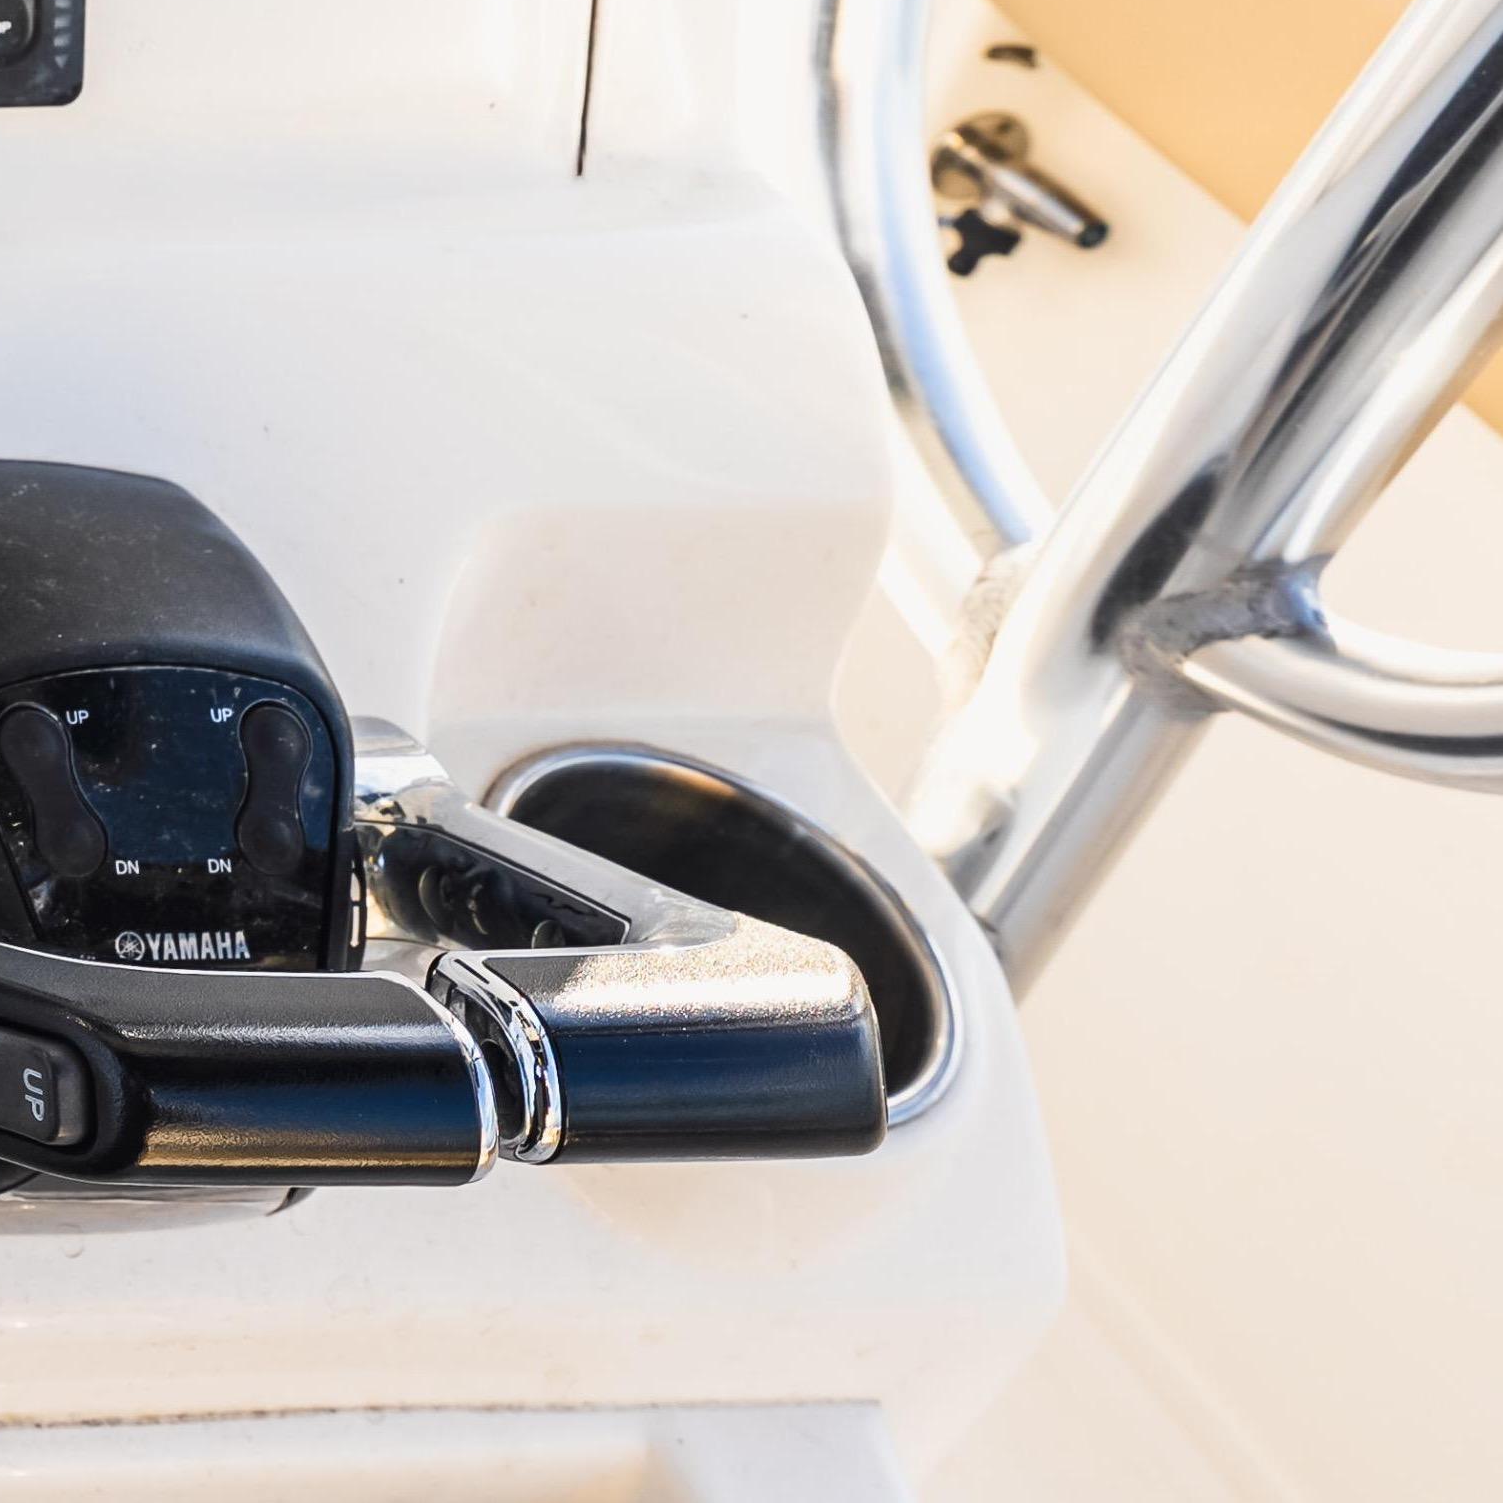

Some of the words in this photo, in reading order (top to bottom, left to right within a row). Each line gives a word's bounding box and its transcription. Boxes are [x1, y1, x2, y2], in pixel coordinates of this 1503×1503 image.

[65, 709, 89, 727] UP
[210, 707, 234, 724] UP
[115, 859, 140, 876] DN
[207, 857, 232, 874] DN
[145, 930, 251, 961] YAMAHA
[22, 1069, 46, 1122] UP
